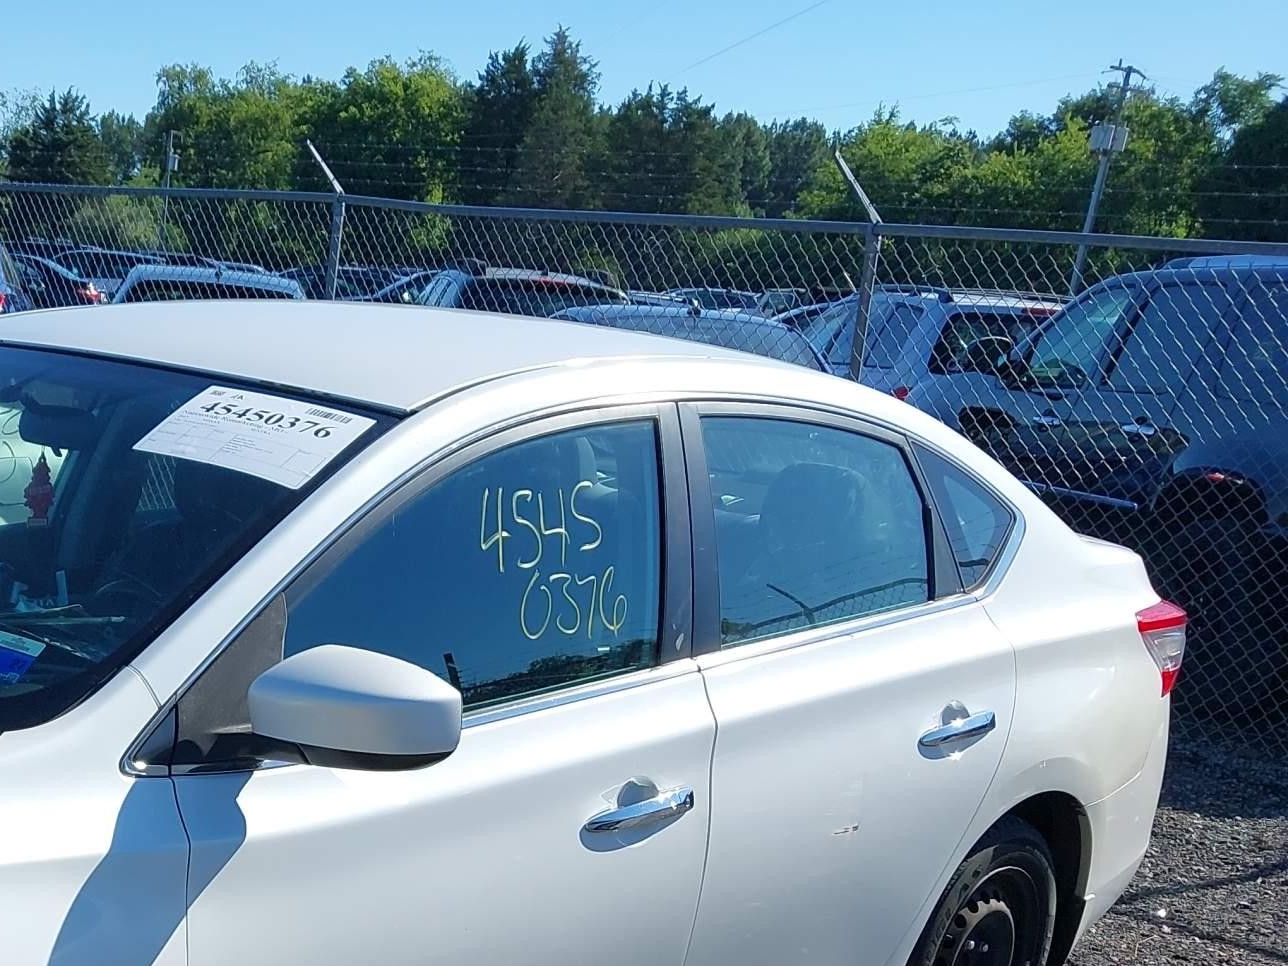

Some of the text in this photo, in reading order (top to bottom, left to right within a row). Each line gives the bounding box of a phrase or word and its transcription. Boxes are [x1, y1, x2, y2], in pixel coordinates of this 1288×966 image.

[200, 401, 338, 439] 45450376
[480, 480, 602, 573] 4545
[520, 565, 628, 640] 0376
